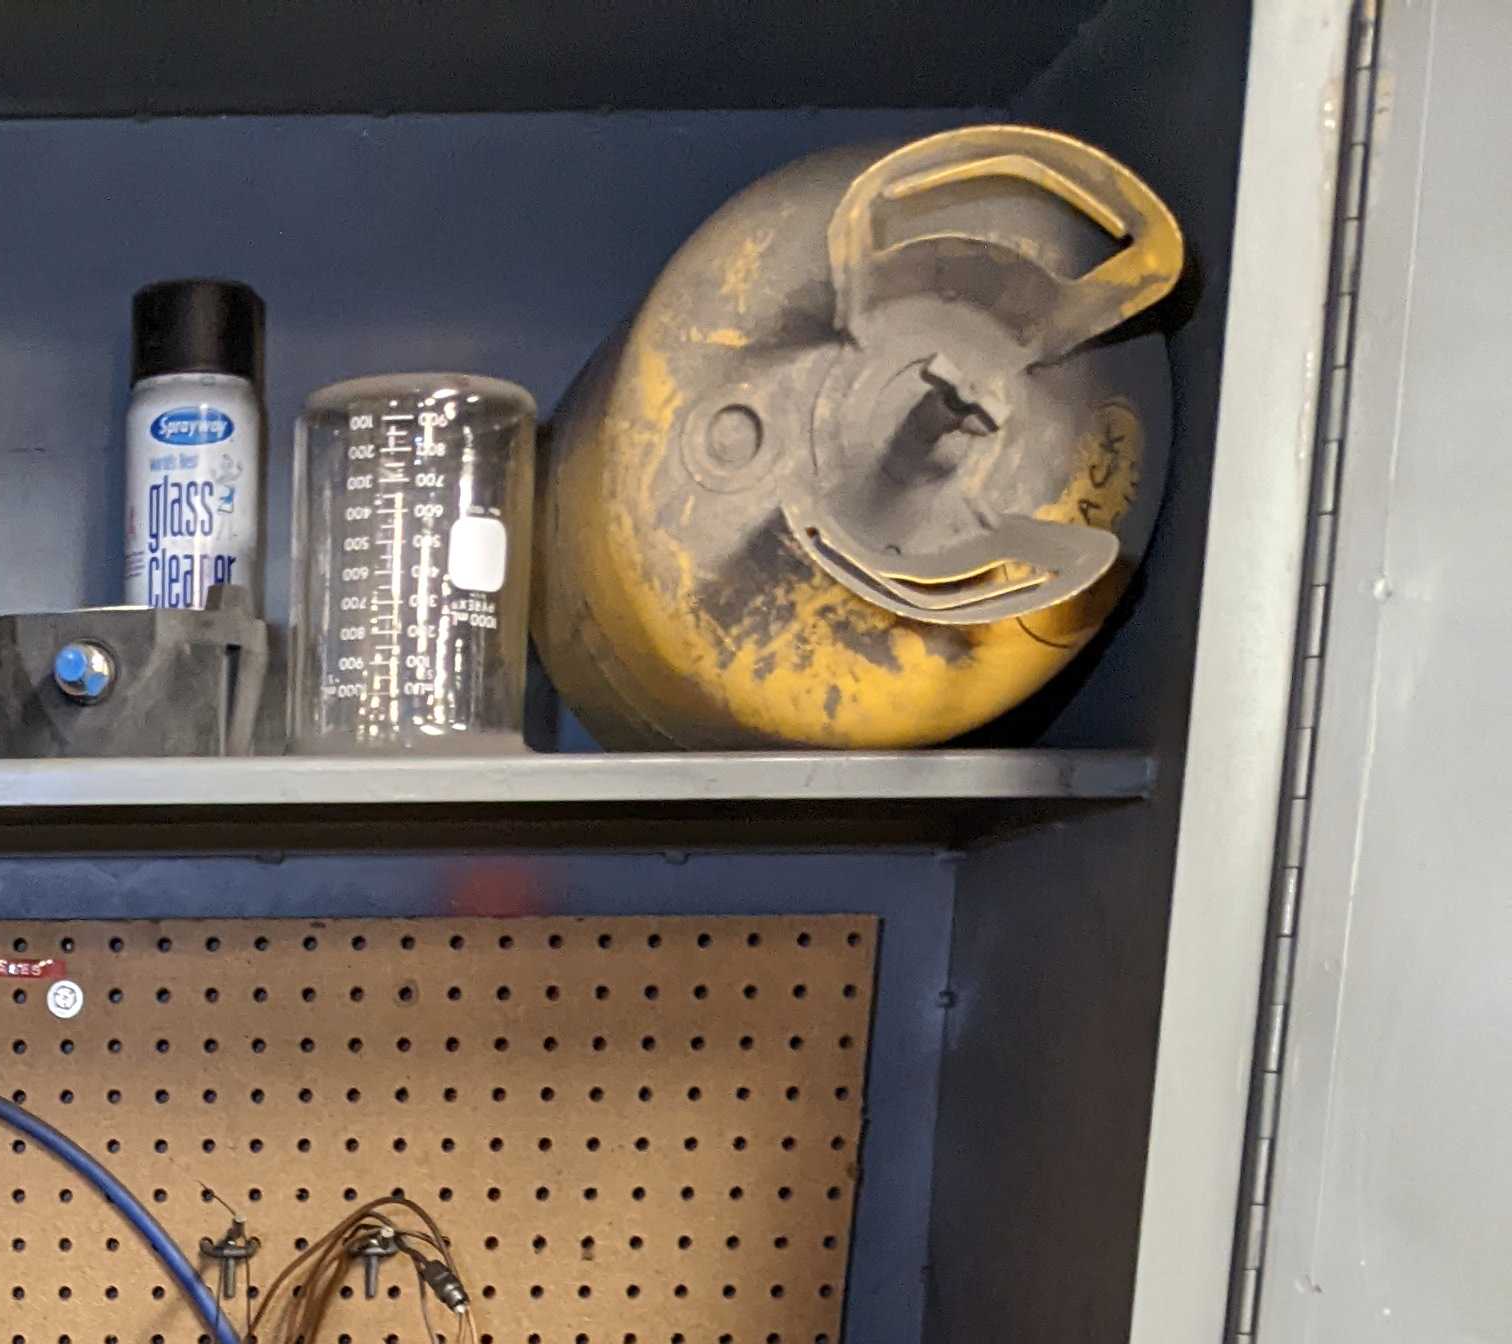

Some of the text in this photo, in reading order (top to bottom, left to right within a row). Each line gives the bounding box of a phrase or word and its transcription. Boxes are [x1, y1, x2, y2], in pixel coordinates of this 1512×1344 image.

[159, 415, 228, 438] Sprayway
[349, 415, 374, 431] 100
[348, 444, 375, 460] 200
[346, 474, 373, 490] 300
[415, 473, 445, 488] 700
[149, 475, 214, 553] glass
[345, 506, 372, 521] 400
[413, 503, 444, 518] 600
[344, 536, 370, 551] 500
[342, 566, 369, 582] 600
[411, 564, 440, 578] 40
[340, 597, 367, 611] 700
[409, 594, 438, 608] 30
[340, 626, 366, 641] 800
[407, 624, 437, 638] 20
[338, 656, 364, 671] 900
